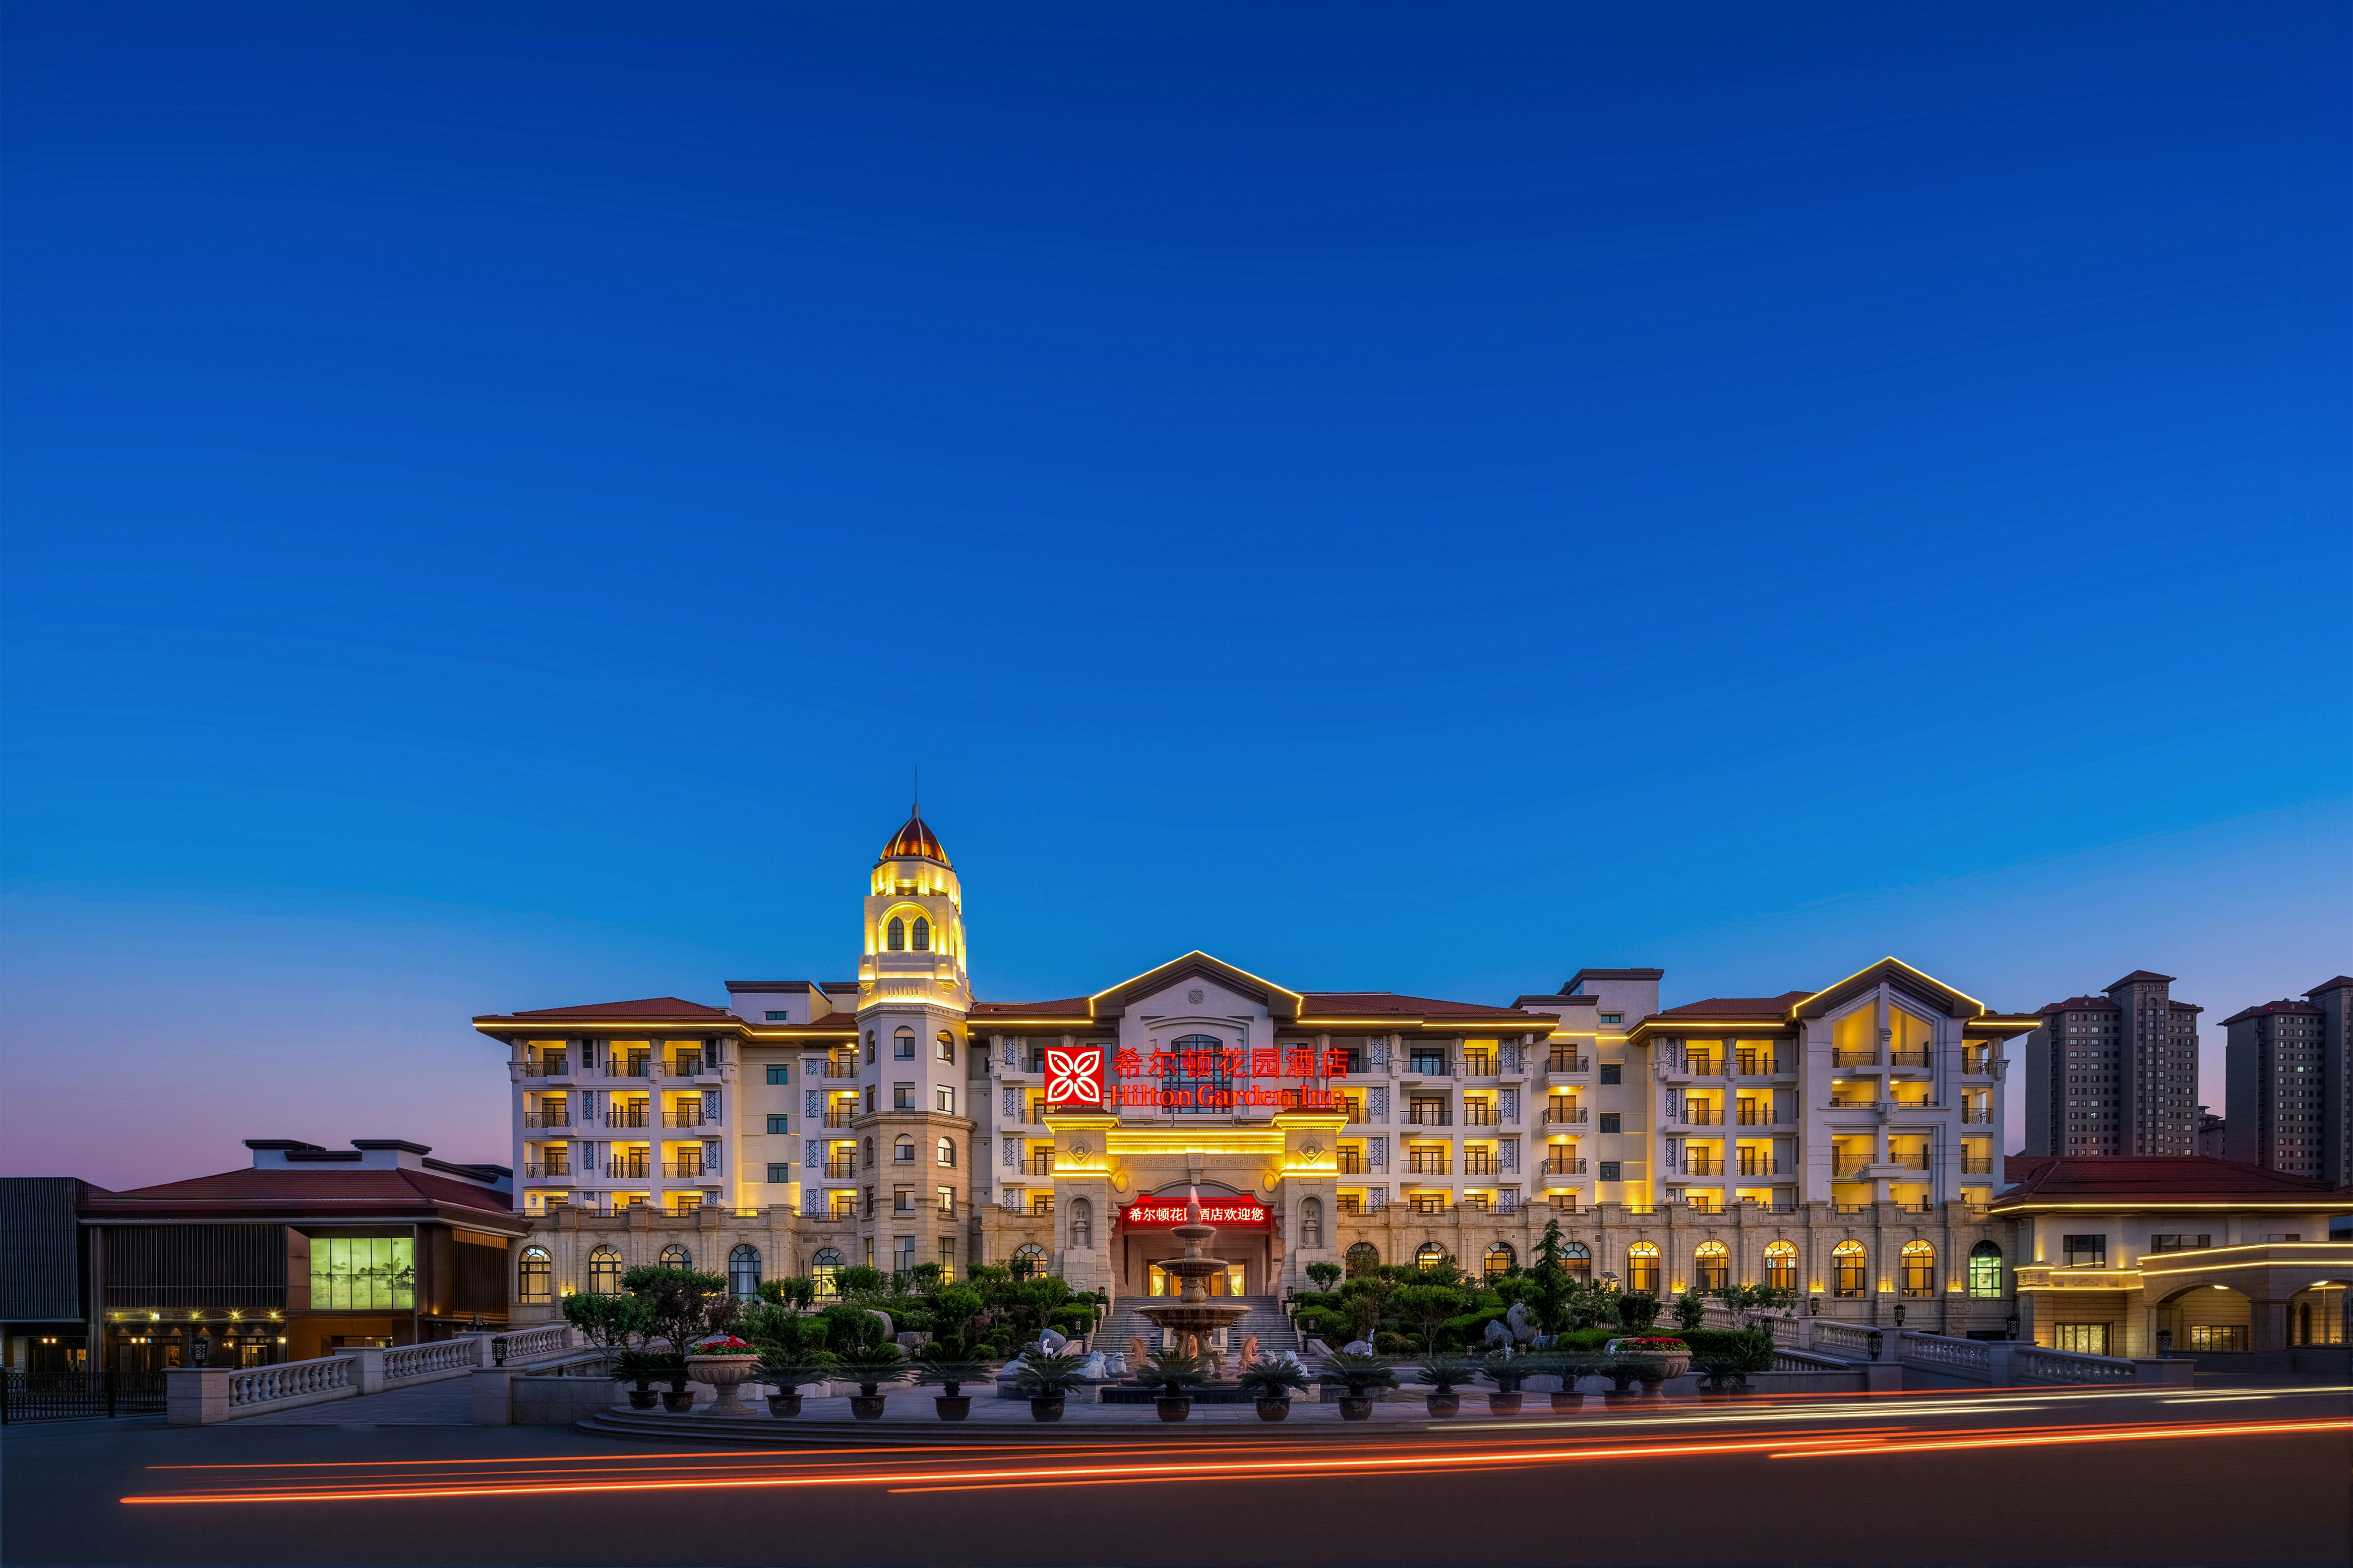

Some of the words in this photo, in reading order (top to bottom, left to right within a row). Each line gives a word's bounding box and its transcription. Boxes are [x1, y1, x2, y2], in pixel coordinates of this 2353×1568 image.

[1113, 1047, 1348, 1079] 希尔顿花园酒店
[1111, 1085, 1192, 1106] Hilton
[1196, 1085, 1294, 1106] Garden
[1300, 1085, 1347, 1105] Inn
[1129, 1208, 1264, 1222] 希尔顿花酒店欢迎您
